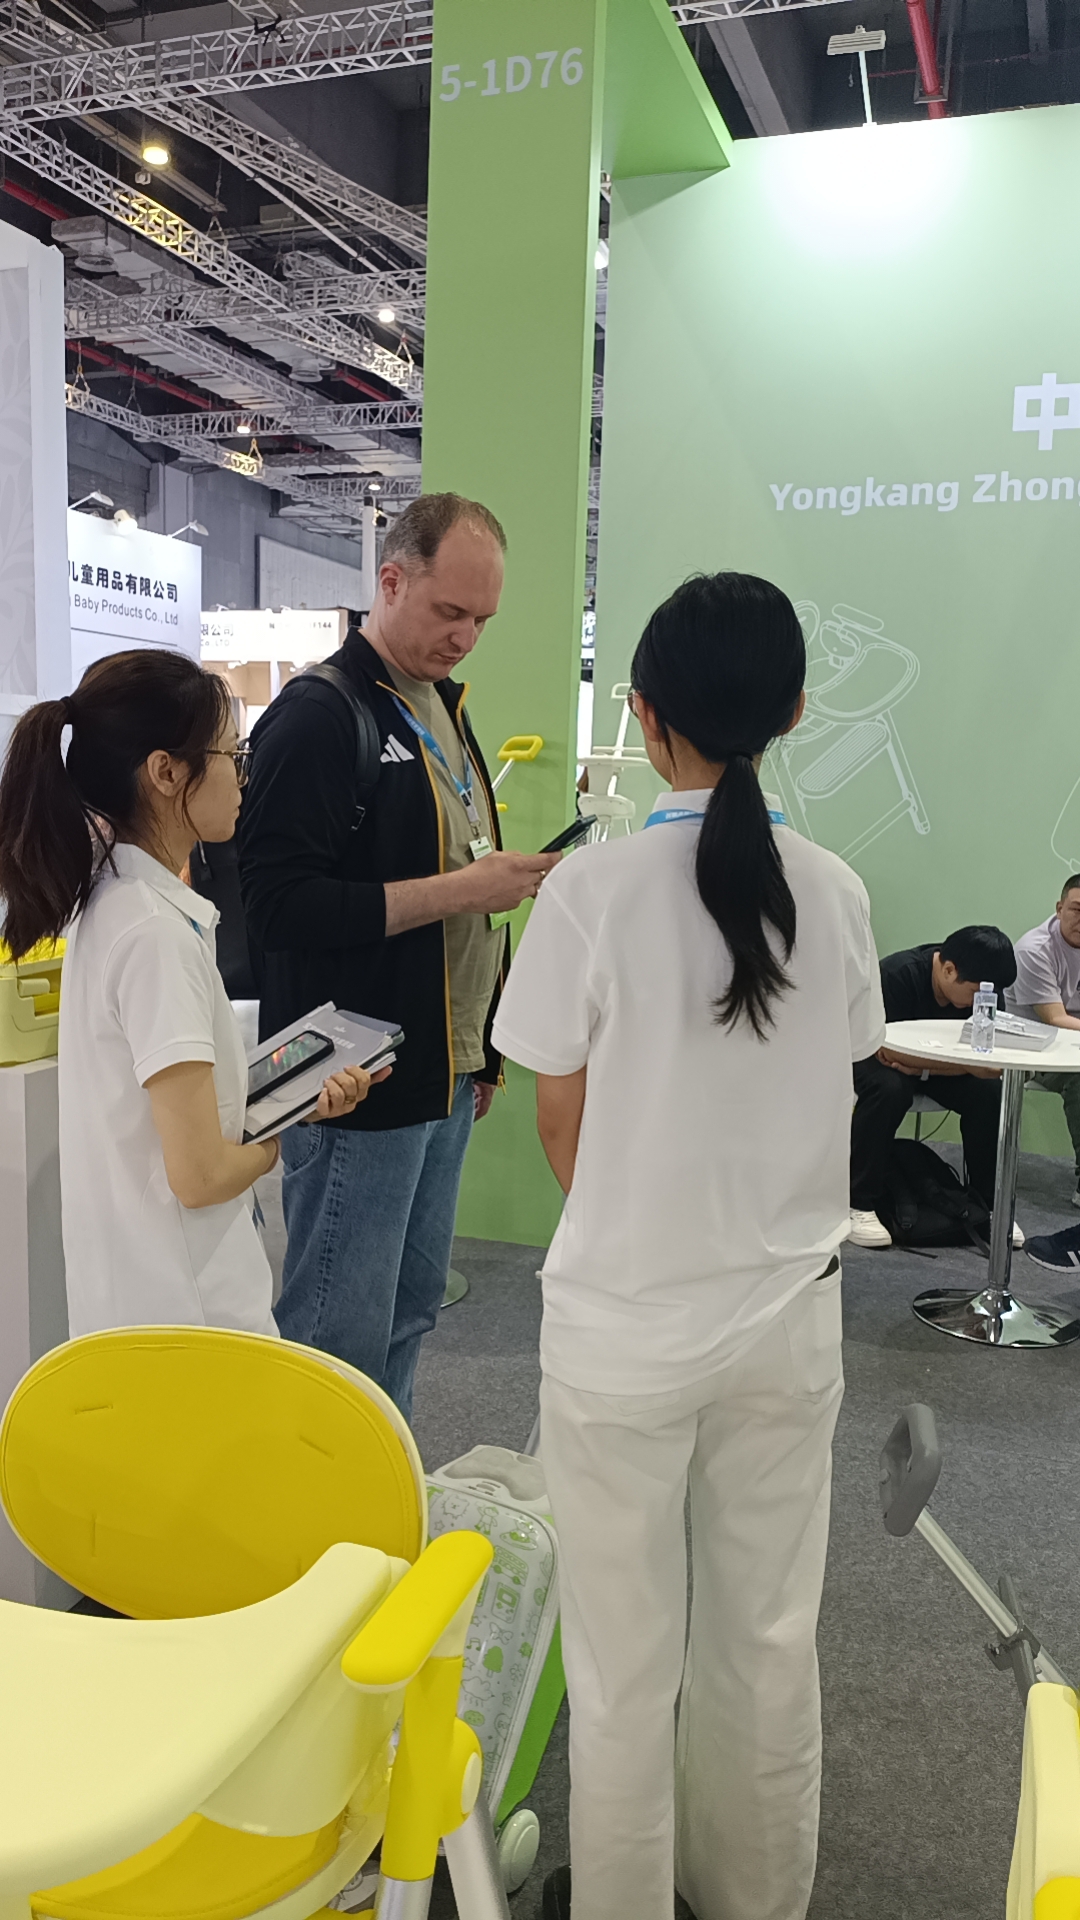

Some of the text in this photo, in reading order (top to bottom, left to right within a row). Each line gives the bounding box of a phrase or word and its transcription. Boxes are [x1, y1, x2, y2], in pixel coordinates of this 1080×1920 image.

[439, 47, 584, 102] 5-1D76
[1012, 372, 1080, 450] 中
[768, 470, 1080, 516] Yongkang Zhon
[68, 560, 178, 603] 儿童用品有限公司
[74, 594, 99, 614] Baby
[101, 599, 142, 619] Products
[165, 612, 178, 625] Ltd
